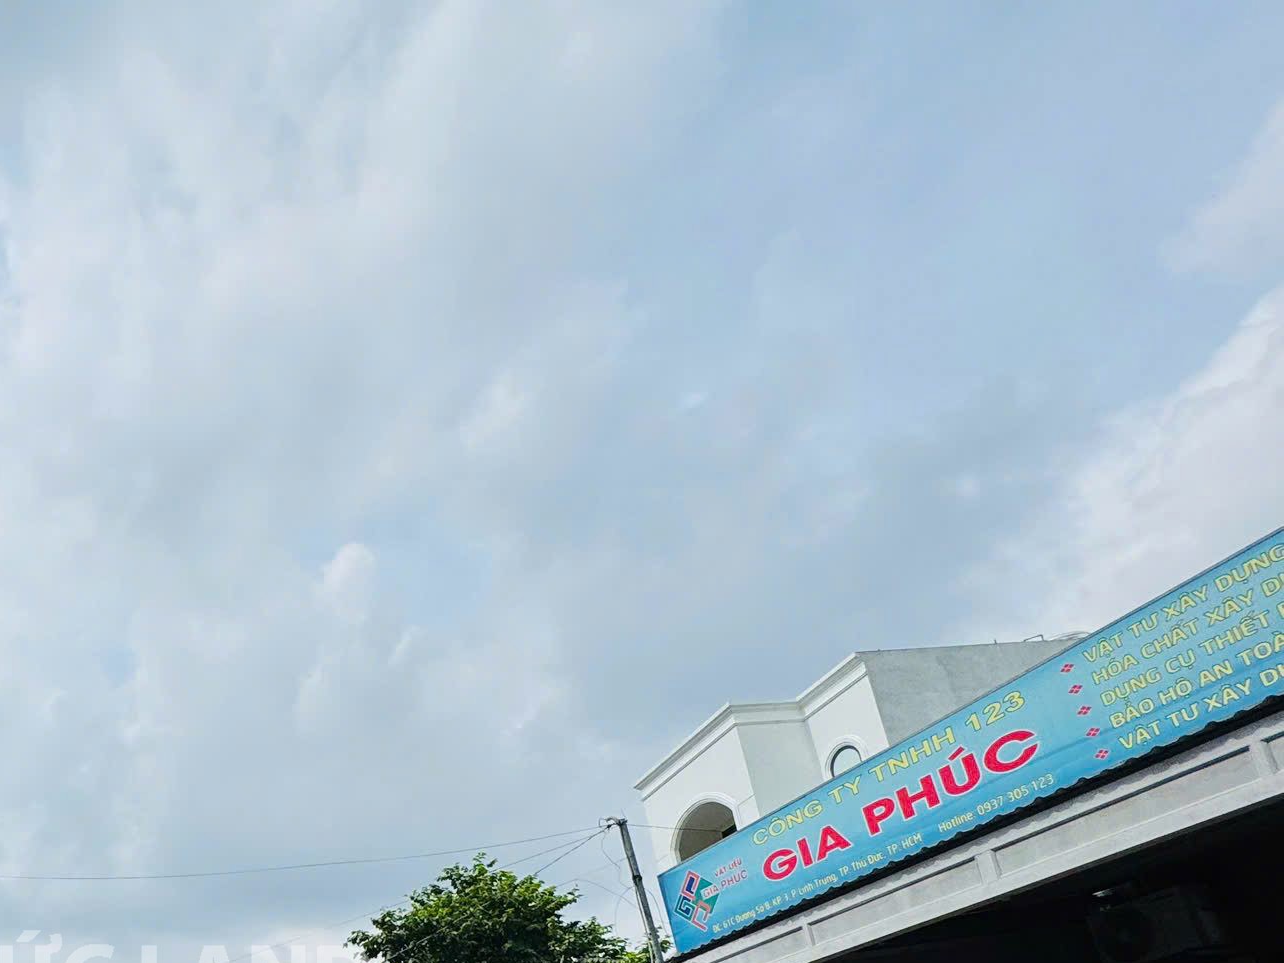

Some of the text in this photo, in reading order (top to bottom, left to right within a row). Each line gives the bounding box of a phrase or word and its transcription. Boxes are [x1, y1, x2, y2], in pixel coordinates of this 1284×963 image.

[1082, 632, 1123, 662] VẬT
[1127, 613, 1159, 638] TƯ
[1162, 584, 1208, 622] XÂY
[1092, 653, 1139, 685] HÓA
[1141, 617, 1199, 659] CHẤT
[1204, 588, 1253, 627] XÂY
[1100, 667, 1162, 707] DỤNG
[1165, 649, 1196, 674] CỤ
[1199, 609, 1269, 656] THIẾT
[1109, 697, 1155, 728] BẢO
[1159, 677, 1192, 705] HỘ
[1199, 659, 1234, 688] AN
[1119, 720, 1161, 749] VẬT
[1166, 702, 1199, 728] TƯ
[1203, 676, 1251, 713] XÂY
[752, 690, 1026, 846] CÔNG TY TNHH 123
[762, 729, 1040, 881] GIA PHÚC
[977, 795, 1005, 815] 0937
[1006, 785, 1030, 802] 305
[1031, 773, 1054, 791] 123
